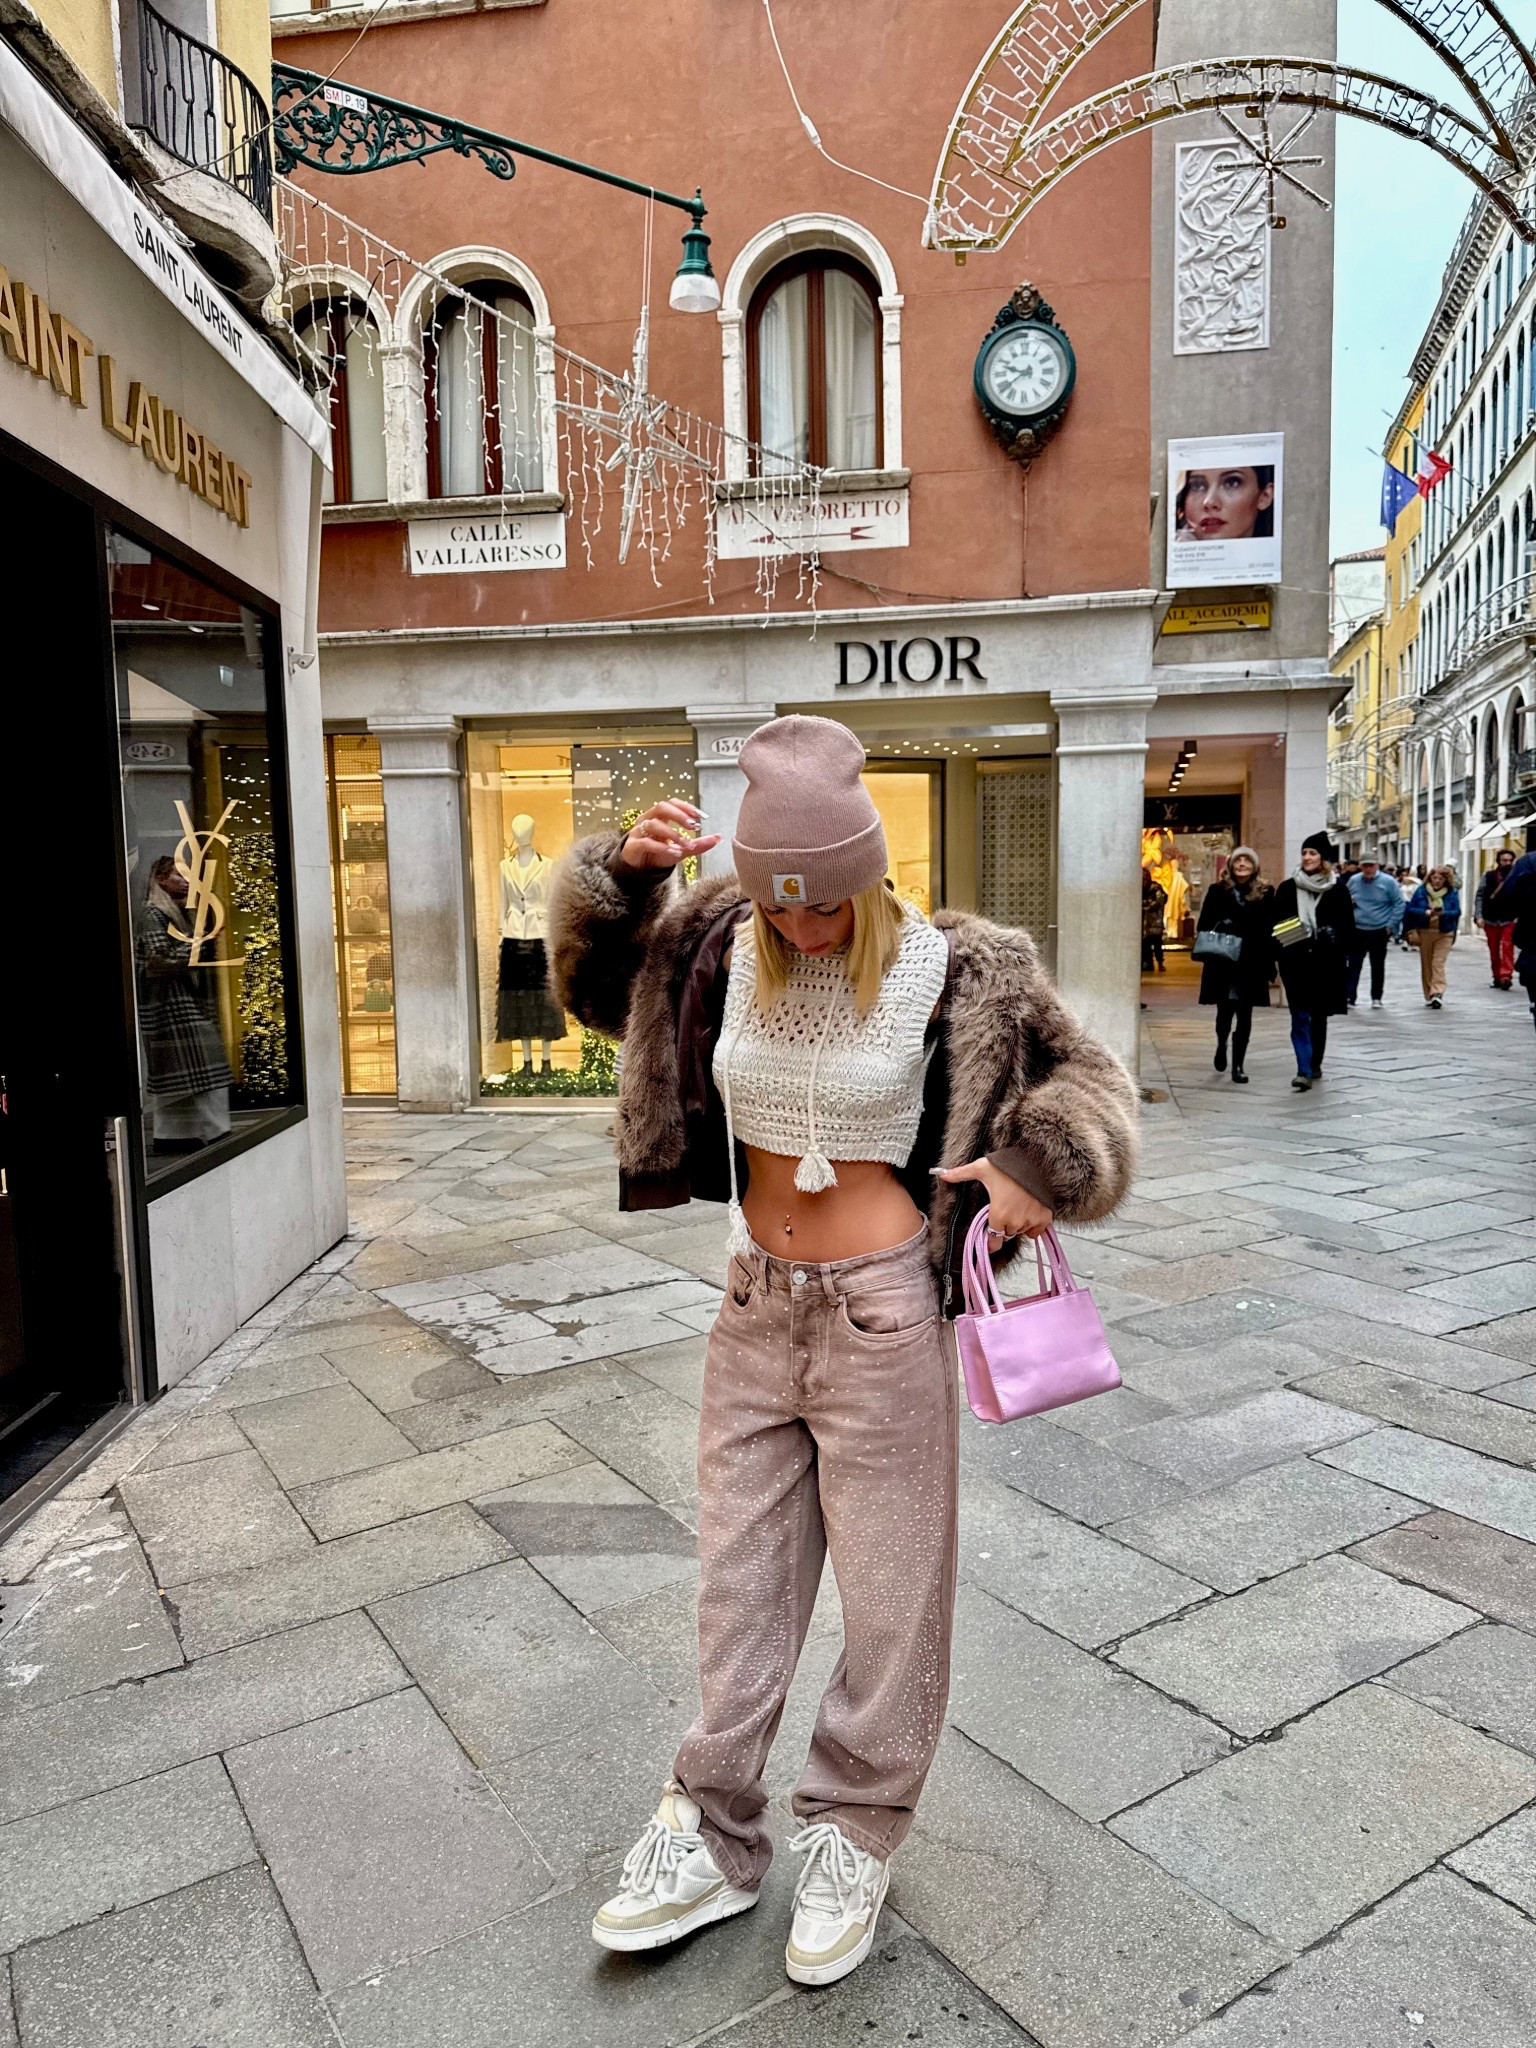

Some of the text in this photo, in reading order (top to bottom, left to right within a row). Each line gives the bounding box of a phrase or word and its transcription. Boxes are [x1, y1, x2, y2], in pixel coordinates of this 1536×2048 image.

[355, 98, 365, 110] 19
[133, 212, 243, 358] SAINT LAURENT
[0, 263, 252, 528] AINT LAURENT
[771, 500, 900, 522] VAPORETTO
[450, 523, 522, 542] CALLE
[416, 543, 562, 566] VALLARESSO
[834, 636, 988, 686] DIOR
